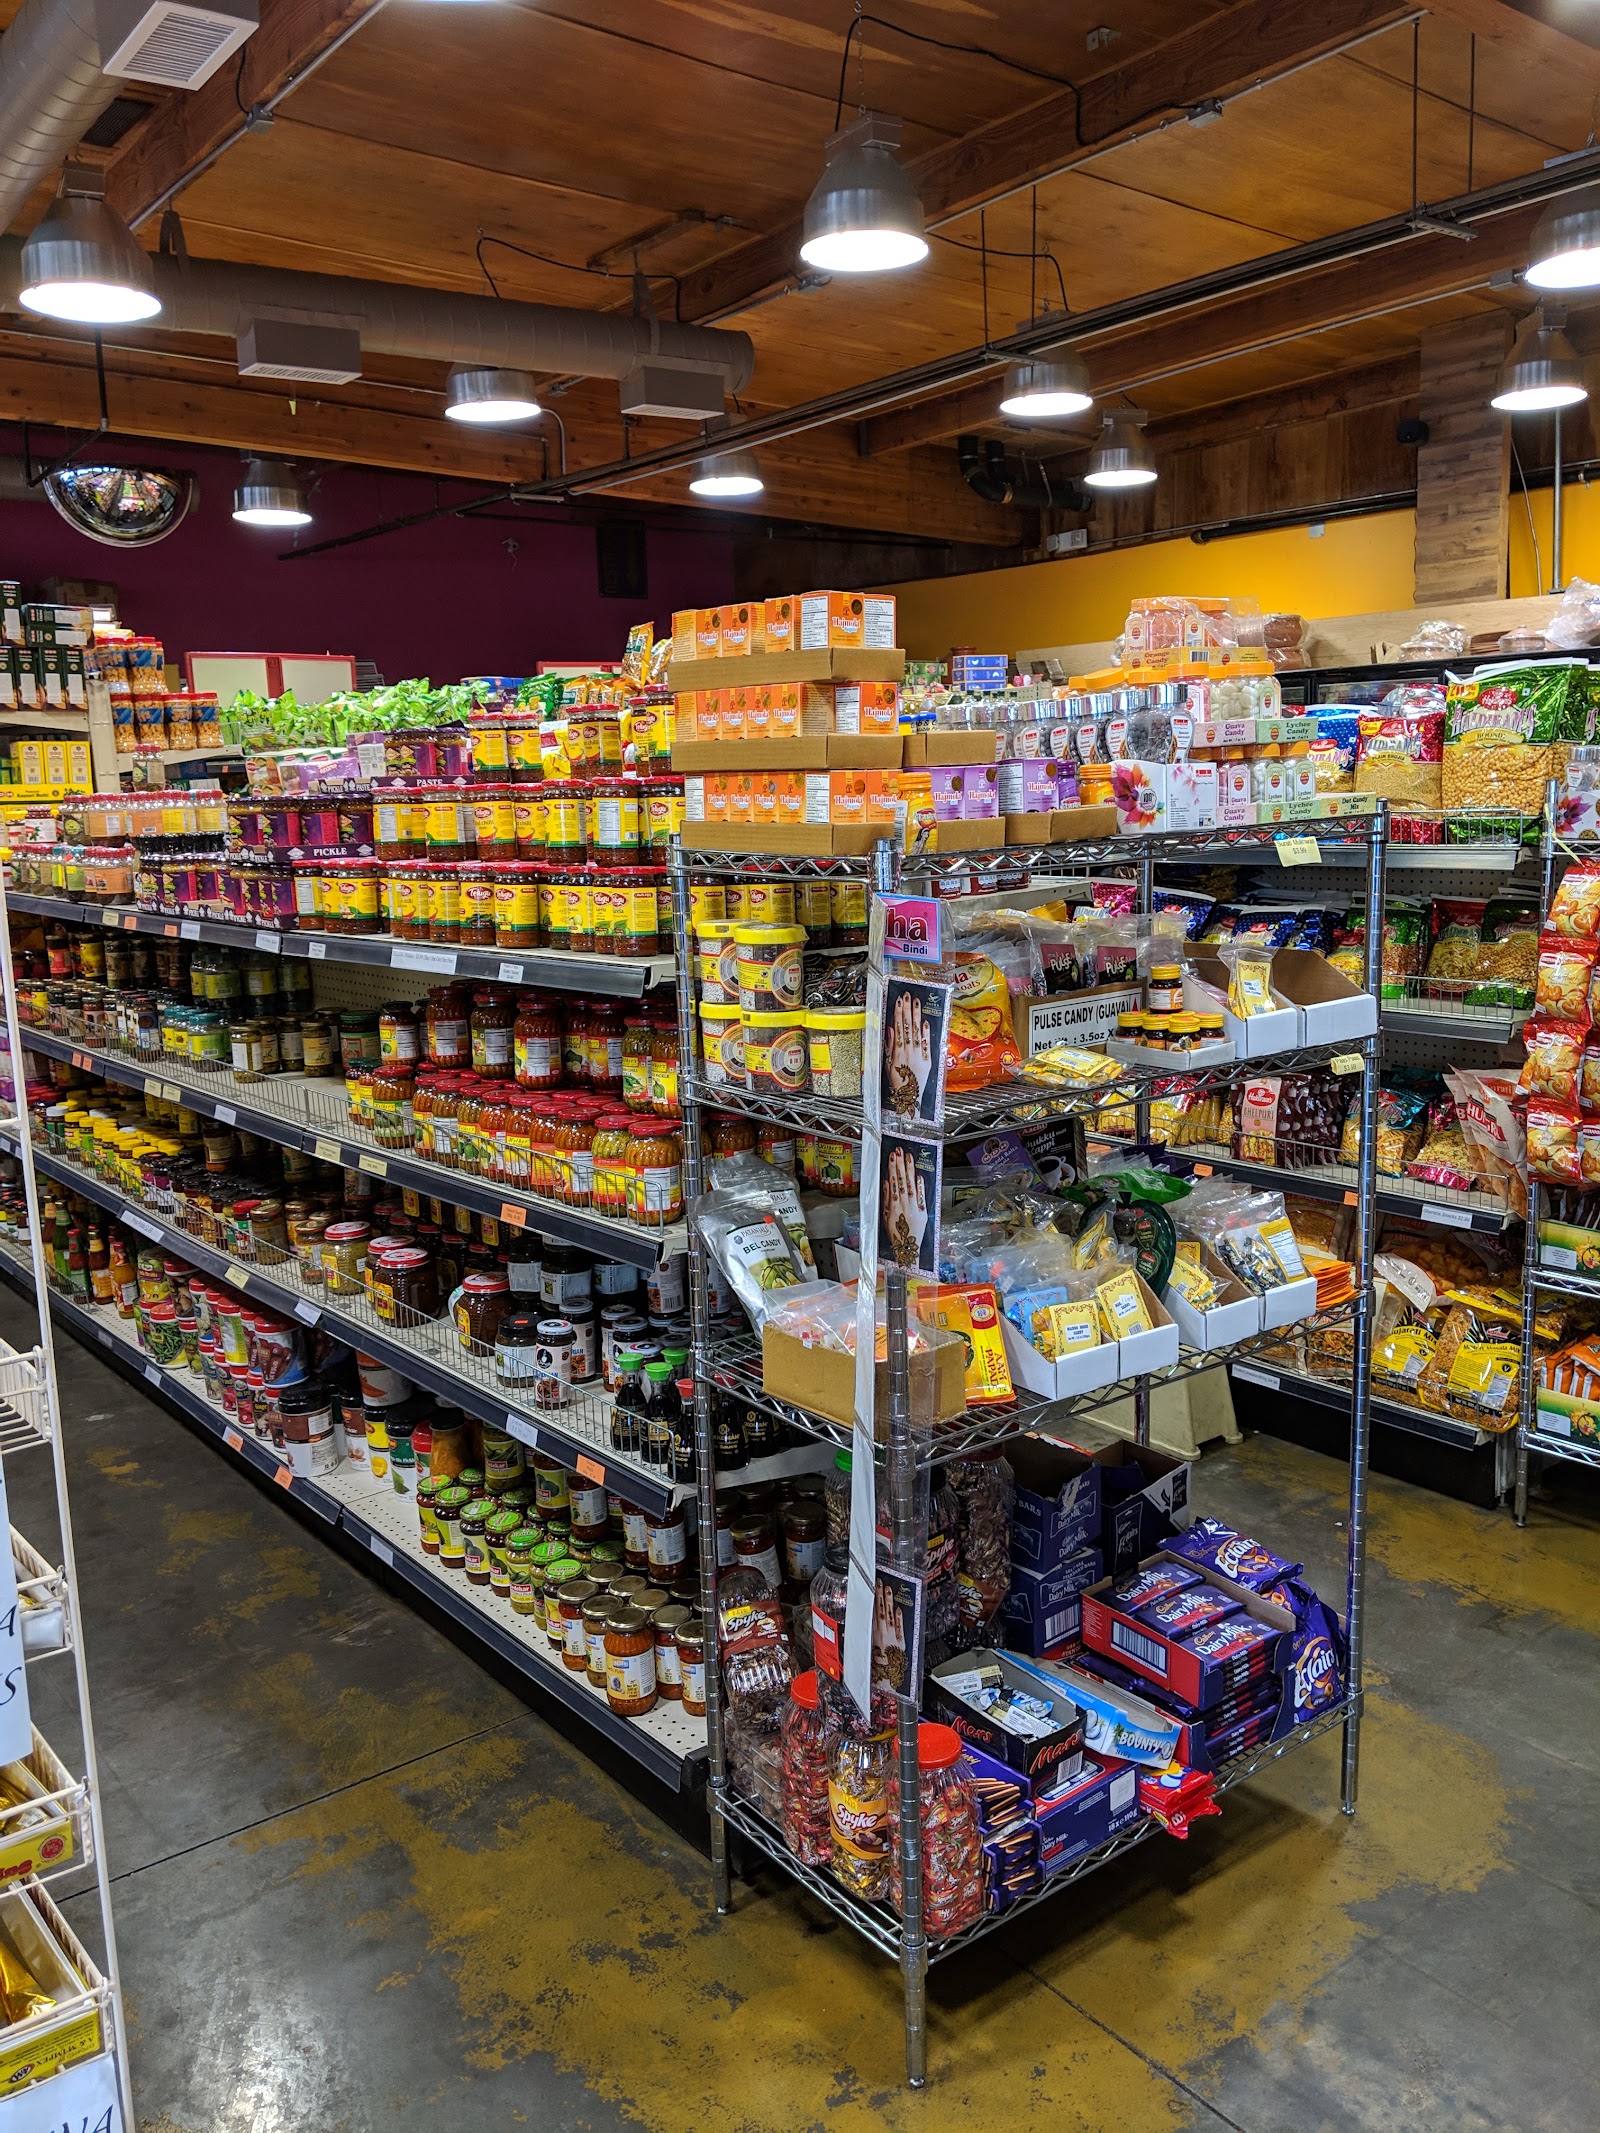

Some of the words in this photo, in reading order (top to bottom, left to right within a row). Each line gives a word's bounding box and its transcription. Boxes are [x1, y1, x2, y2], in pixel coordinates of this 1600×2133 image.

[832, 617, 861, 627] Hajmola
[773, 708, 796, 719] Hajmola
[863, 706, 894, 717] Hajmola
[417, 779, 443, 787] PASTE
[1028, 782, 1056, 791] Hajmola
[834, 795, 863, 805] Hajmola
[934, 792, 962, 802] Hajmola
[968, 791, 996, 801] Hajmola
[1351, 796, 1368, 804] Candy
[313, 848, 347, 856] PICKLE
[468, 887, 491, 898] Telugu
[496, 890, 513, 898] Telugu
[903, 944, 928, 955] Bindi
[1050, 953, 1072, 971] PULSE
[1106, 957, 1126, 974] PULSE
[1034, 1012, 1062, 1030] PULSE
[1064, 1007, 1094, 1026] CANDY
[1034, 1040, 1052, 1051] Net
[1080, 1032, 1104, 1042] 3.5oz
[1243, 1107, 1274, 1120] BHELPURI
[1026, 1131, 1055, 1148] hukku
[778, 1206, 797, 1214] ANDY
[743, 1241, 760, 1254] BEL
[761, 1239, 781, 1248] CANDY
[1424, 1331, 1437, 1345] Mix
[985, 1349, 998, 1387] PAPAD
[994, 1353, 1007, 1381] AAM
[1019, 1501, 1042, 1517] BARS
[1058, 1541, 1075, 1558] Dairy
[1074, 1528, 1089, 1545] Milk
[1215, 1538, 1261, 1578] Eclairs
[959, 1586, 983, 1600] yke
[1048, 1587, 1064, 1602] Dairy
[1063, 1580, 1078, 1596] Milk
[1116, 1582, 1149, 1602] Dairy
[1146, 1571, 1171, 1591] Milk
[1156, 1601, 1178, 1613] Cadbury
[1156, 1604, 1190, 1623] Dairy
[1186, 1594, 1213, 1612] Milk
[727, 1610, 768, 1632] Spyke
[1194, 1630, 1216, 1646] Cadbury
[1195, 1634, 1230, 1655] Dairy
[1225, 1624, 1252, 1642] Milk
[951, 1716, 992, 1743] Mars
[1120, 1732, 1162, 1753] BOUNTY
[1030, 1728, 1083, 1774] Mars
[836, 1803, 877, 1829] Spyke
[36, 2049, 66, 2066] IMPEX
